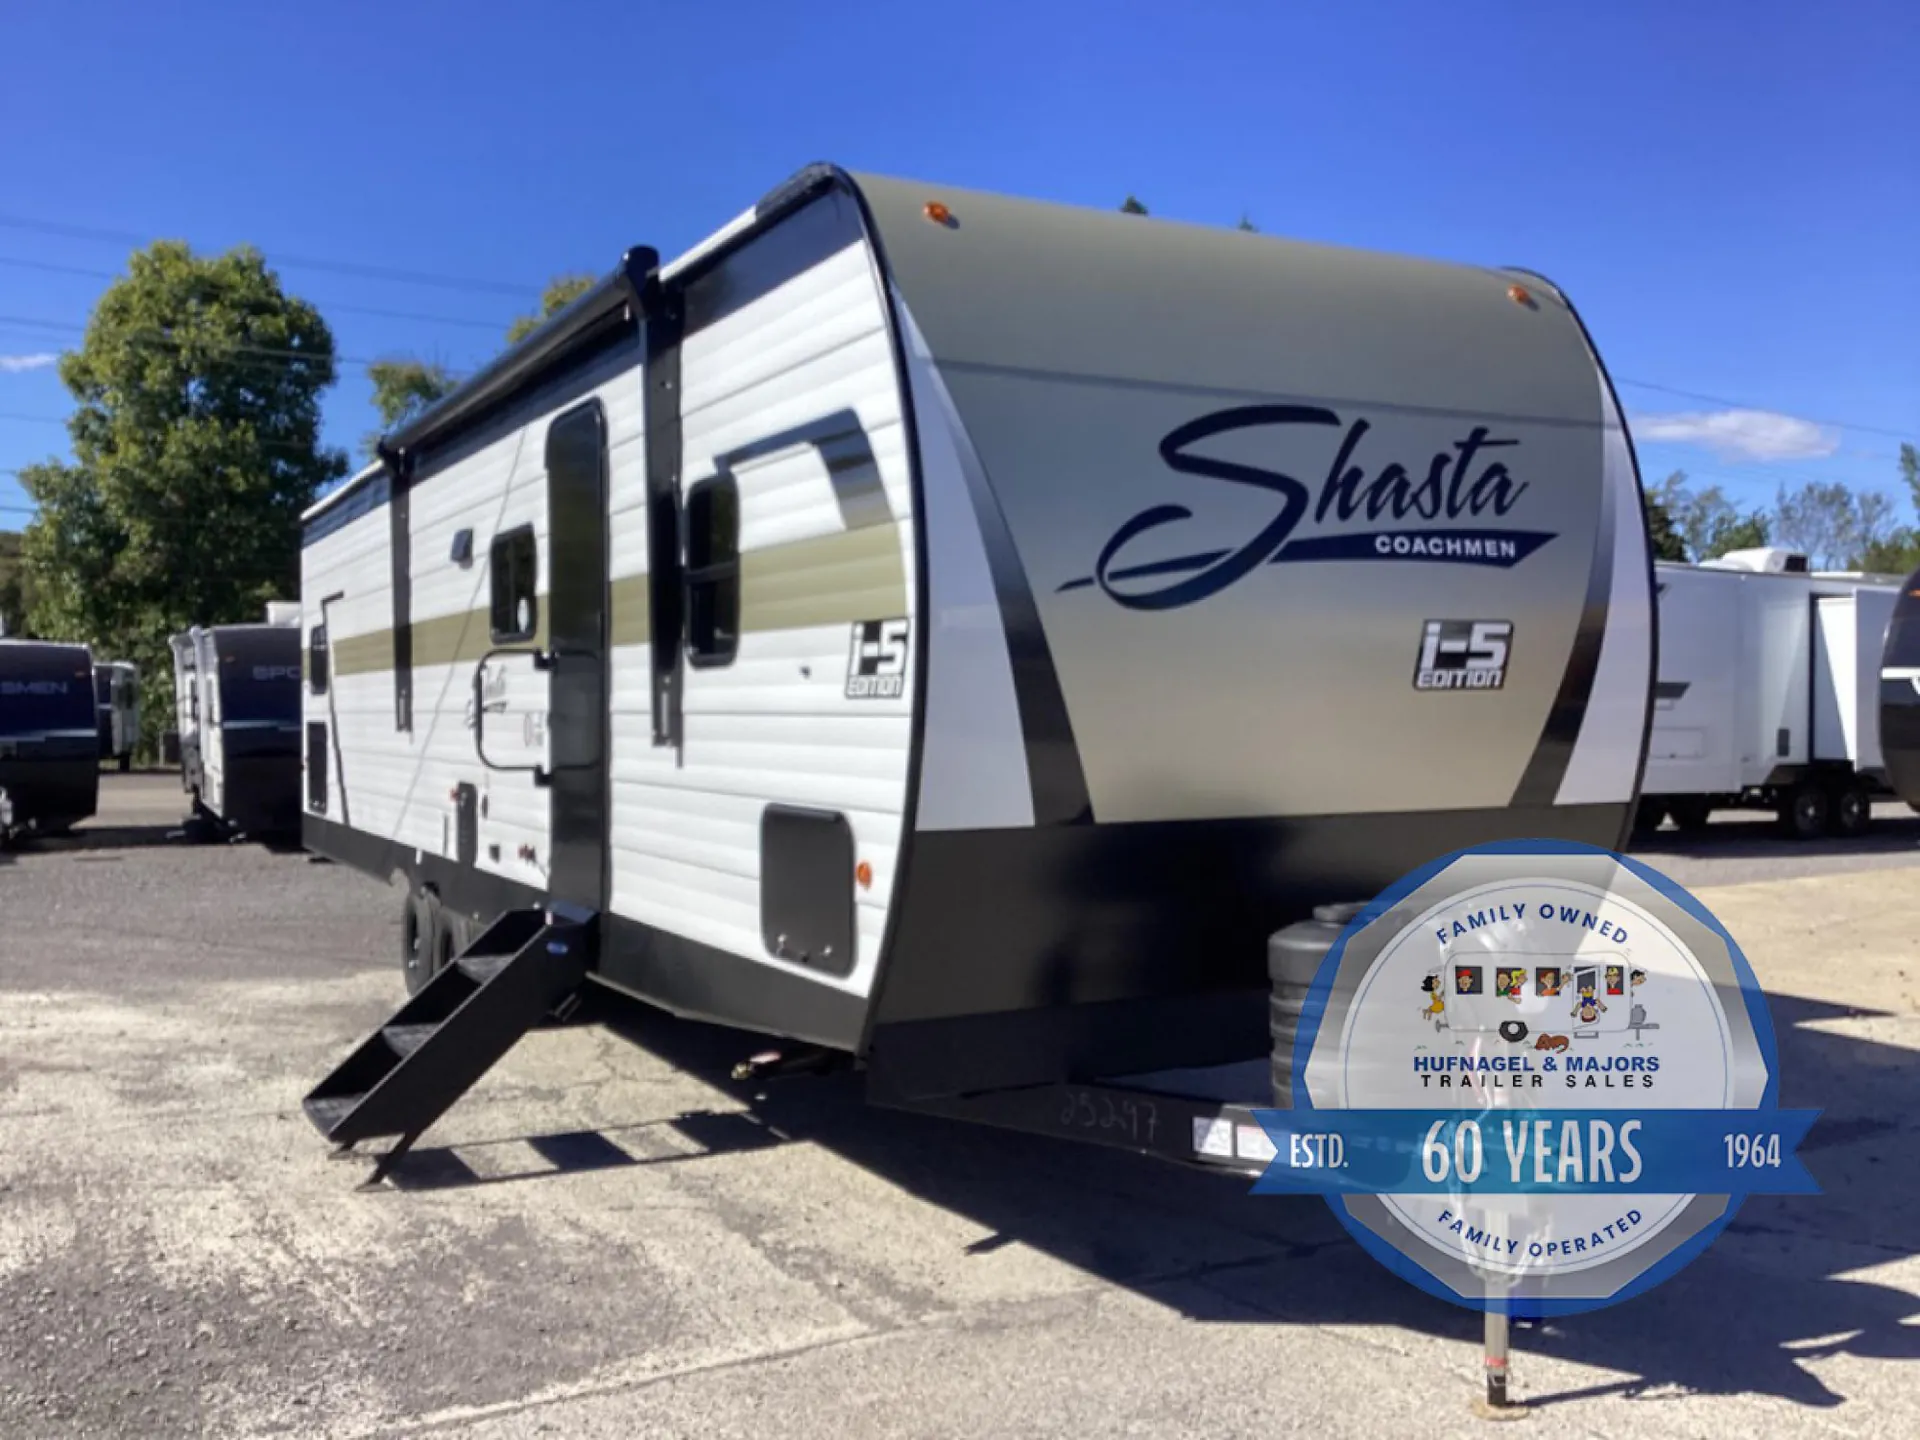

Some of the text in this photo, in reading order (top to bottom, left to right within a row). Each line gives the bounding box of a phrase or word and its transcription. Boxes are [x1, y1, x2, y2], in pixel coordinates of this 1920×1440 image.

[1096, 403, 1529, 611] Shasta
[1374, 534, 1516, 558] COACHMEN
[1416, 669, 1503, 688] EDITION
